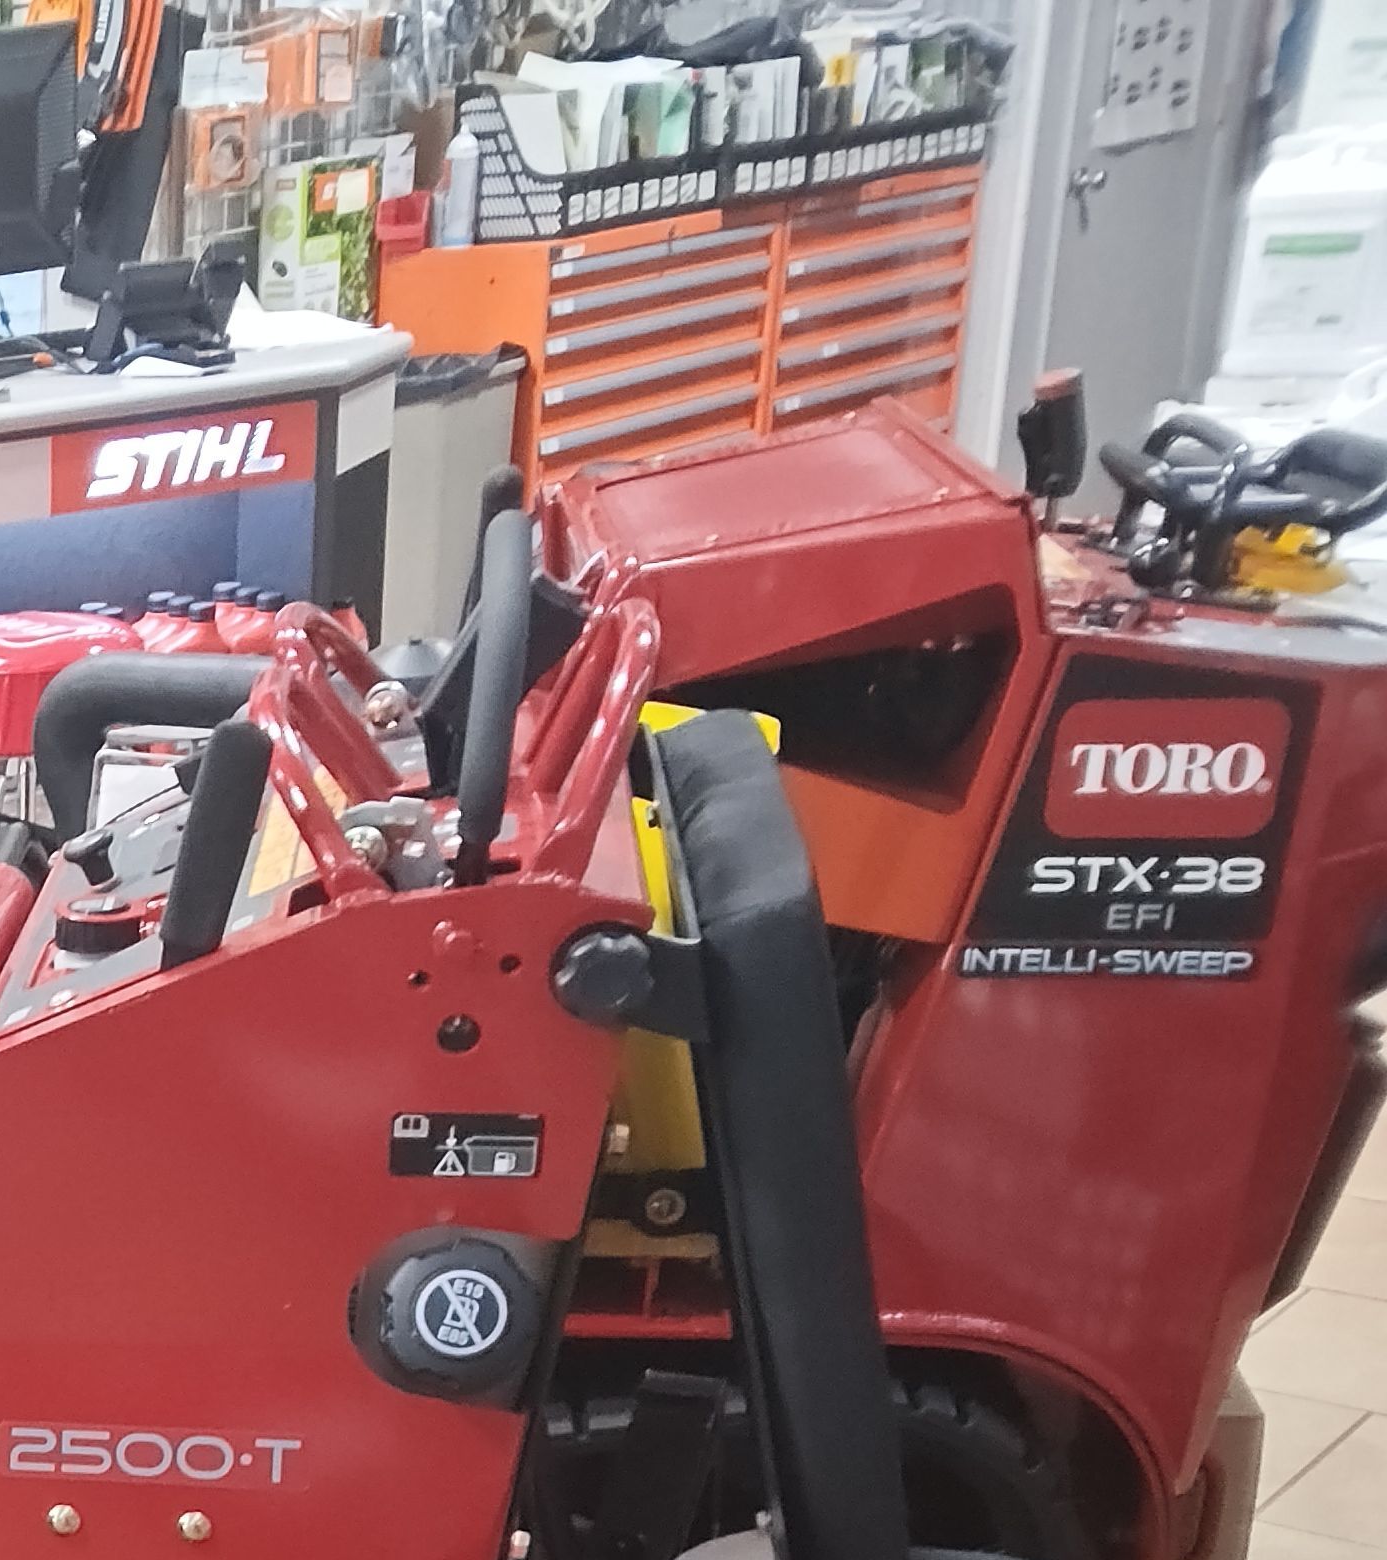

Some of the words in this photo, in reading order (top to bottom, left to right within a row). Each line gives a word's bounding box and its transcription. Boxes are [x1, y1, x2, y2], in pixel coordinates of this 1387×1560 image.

[86, 419, 286, 498] STIHL
[1070, 742, 1266, 794] TORO
[1106, 903, 1176, 931] EFI
[963, 947, 1253, 975] INTELLI-SWEEP
